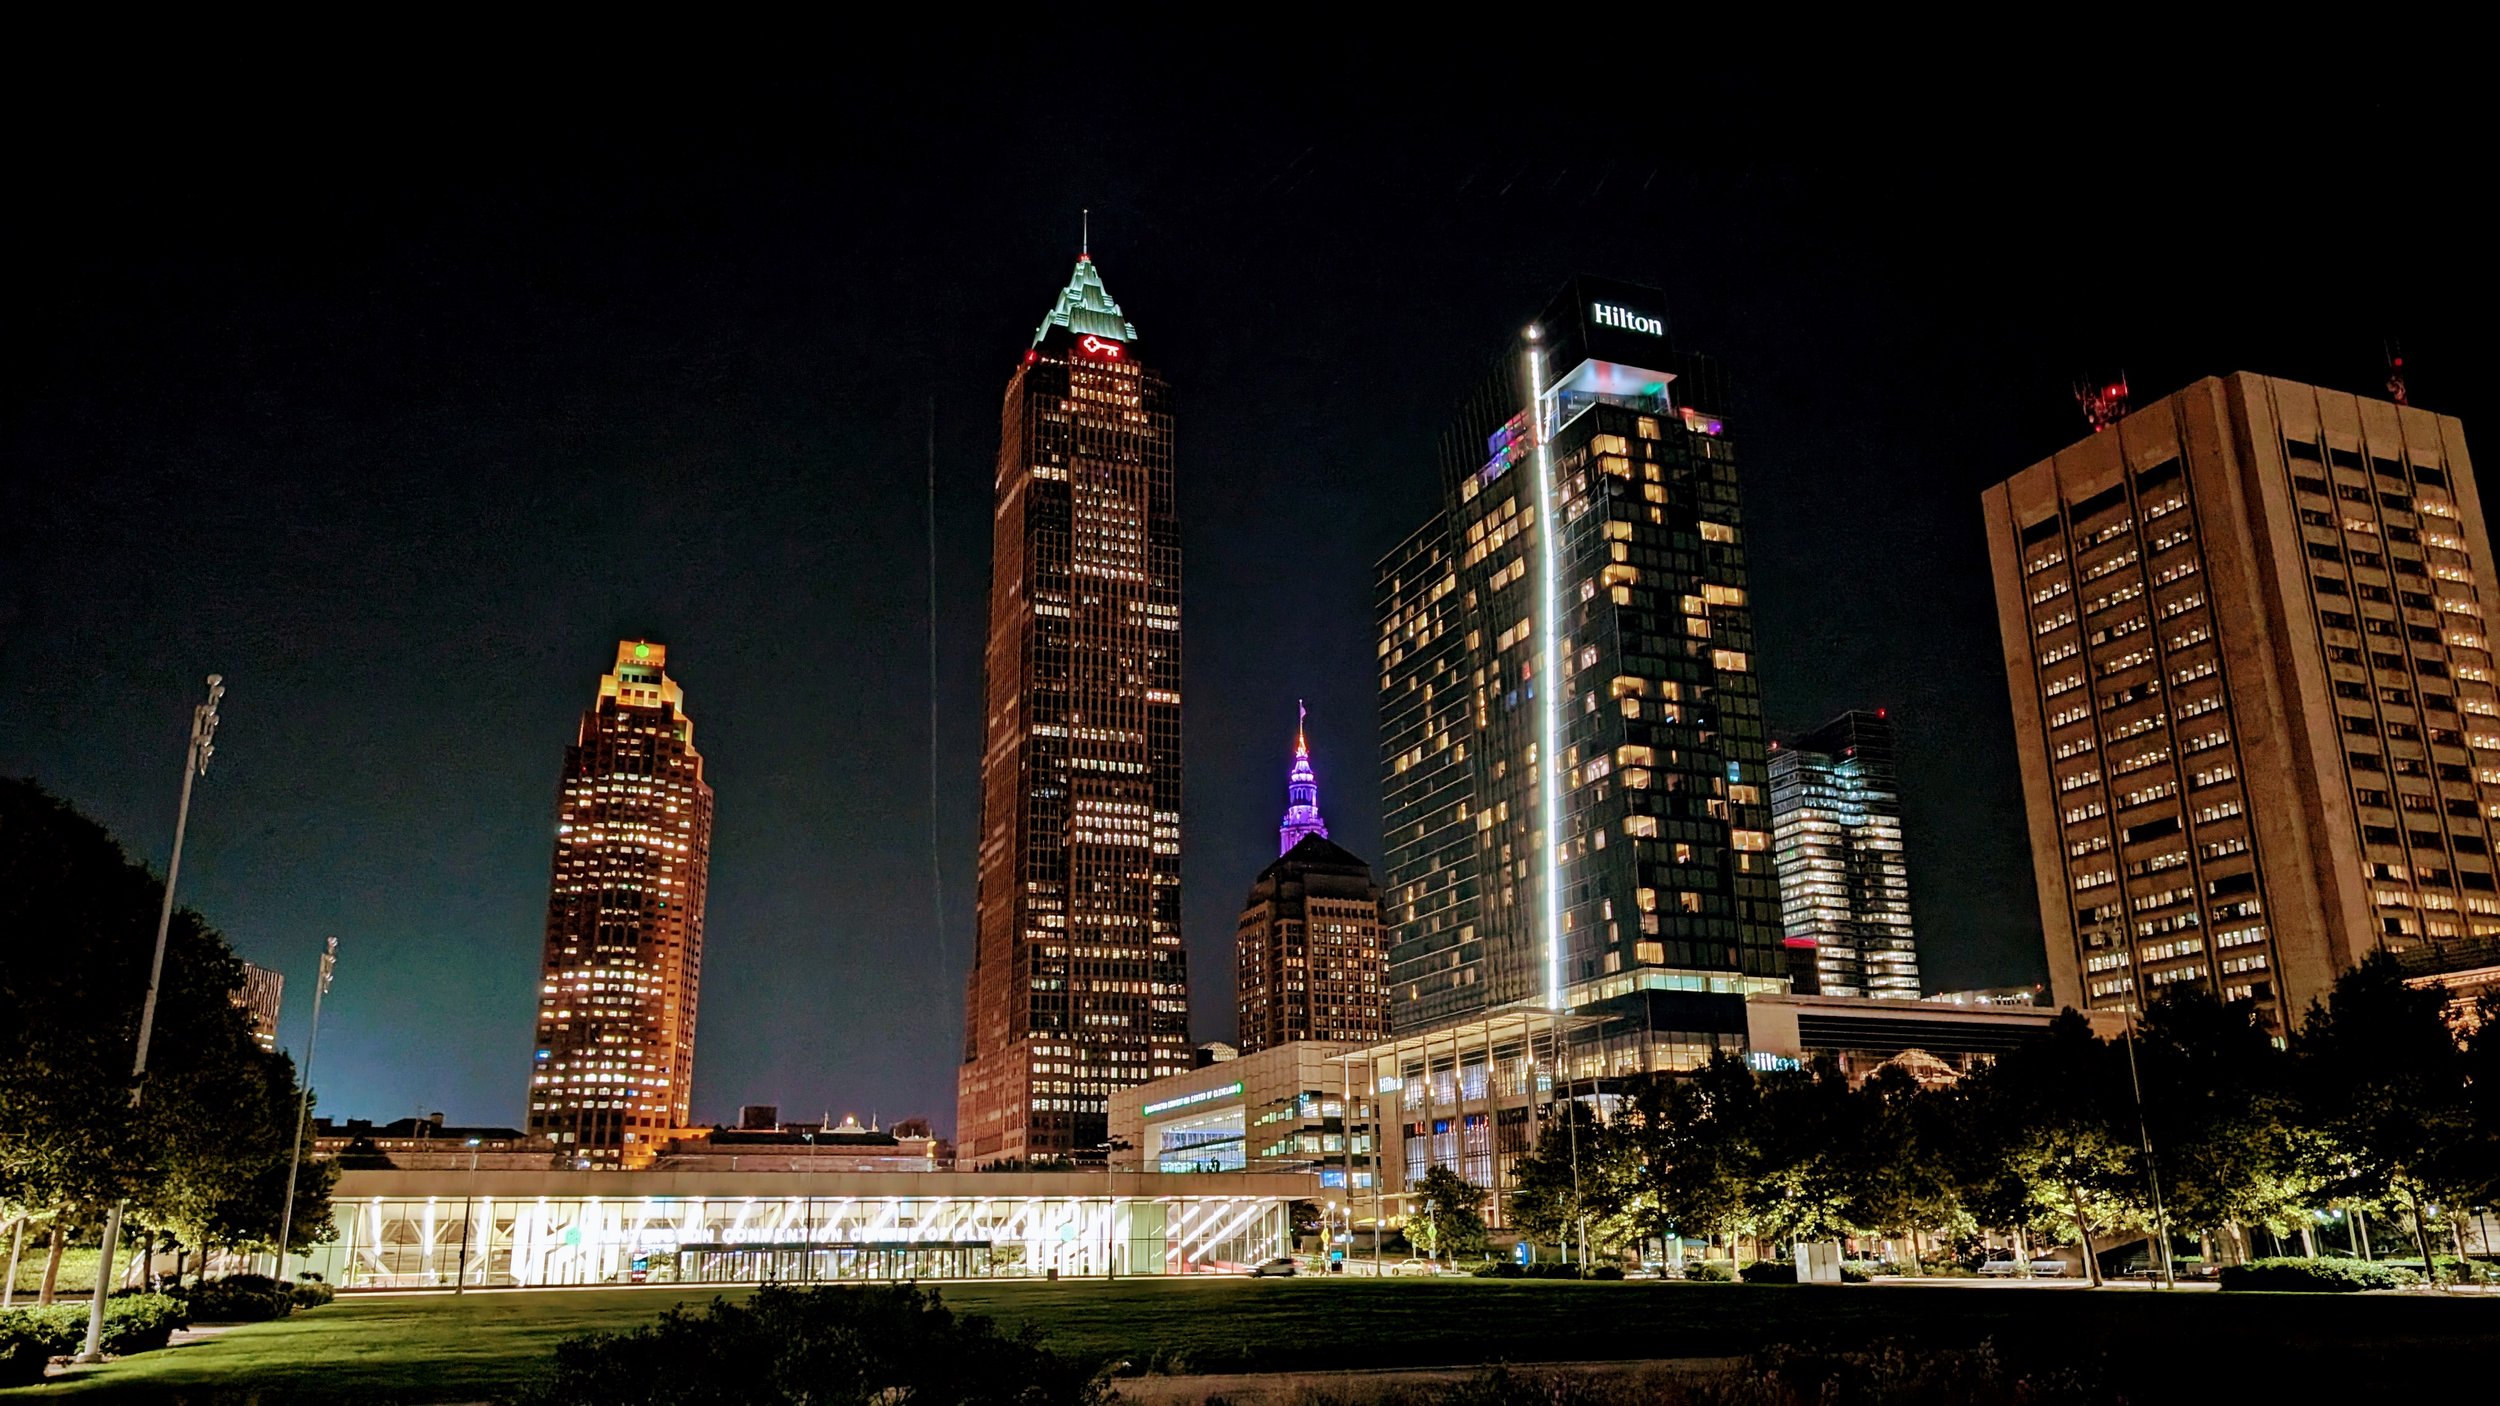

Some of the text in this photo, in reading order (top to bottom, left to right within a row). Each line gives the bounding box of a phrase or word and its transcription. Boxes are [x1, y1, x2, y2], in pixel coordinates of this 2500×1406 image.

[1594, 303, 1663, 336] Hilton
[722, 1227, 843, 1244] CONVENTION
[850, 1227, 919, 1242] CER
[955, 1226, 1060, 1242] CLEVEL
